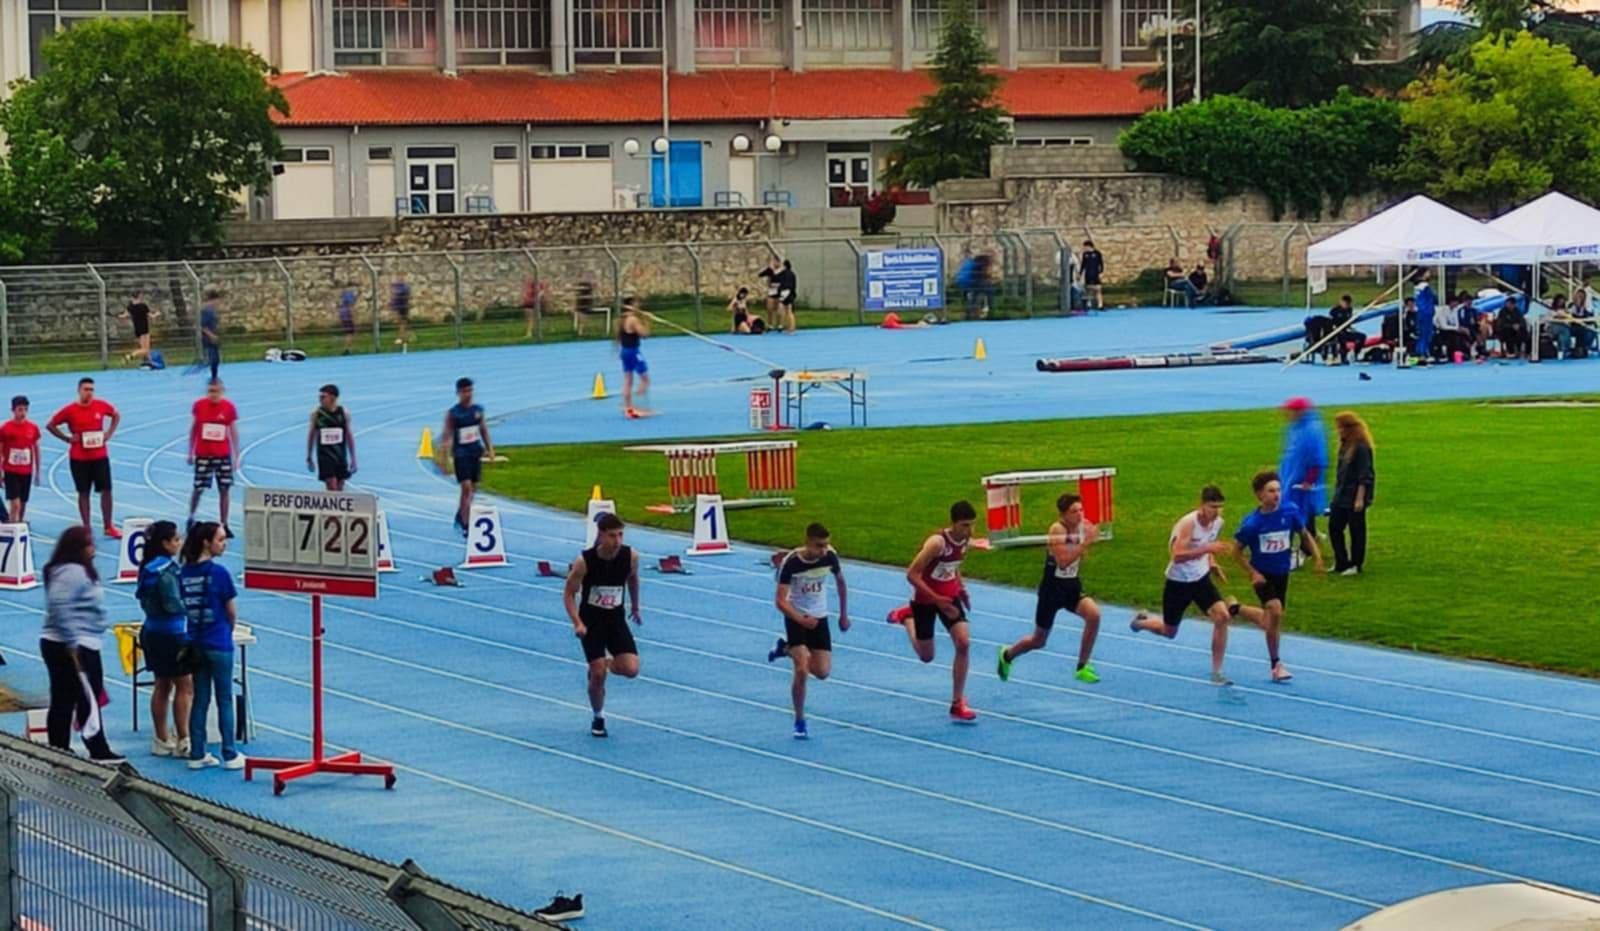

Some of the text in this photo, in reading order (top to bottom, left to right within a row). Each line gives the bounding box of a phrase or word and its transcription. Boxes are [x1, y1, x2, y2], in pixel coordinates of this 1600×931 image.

[263, 493, 354, 512] PERFORMANCE
[474, 517, 497, 553] 3
[702, 505, 717, 540] 1
[127, 530, 147, 567] 6
